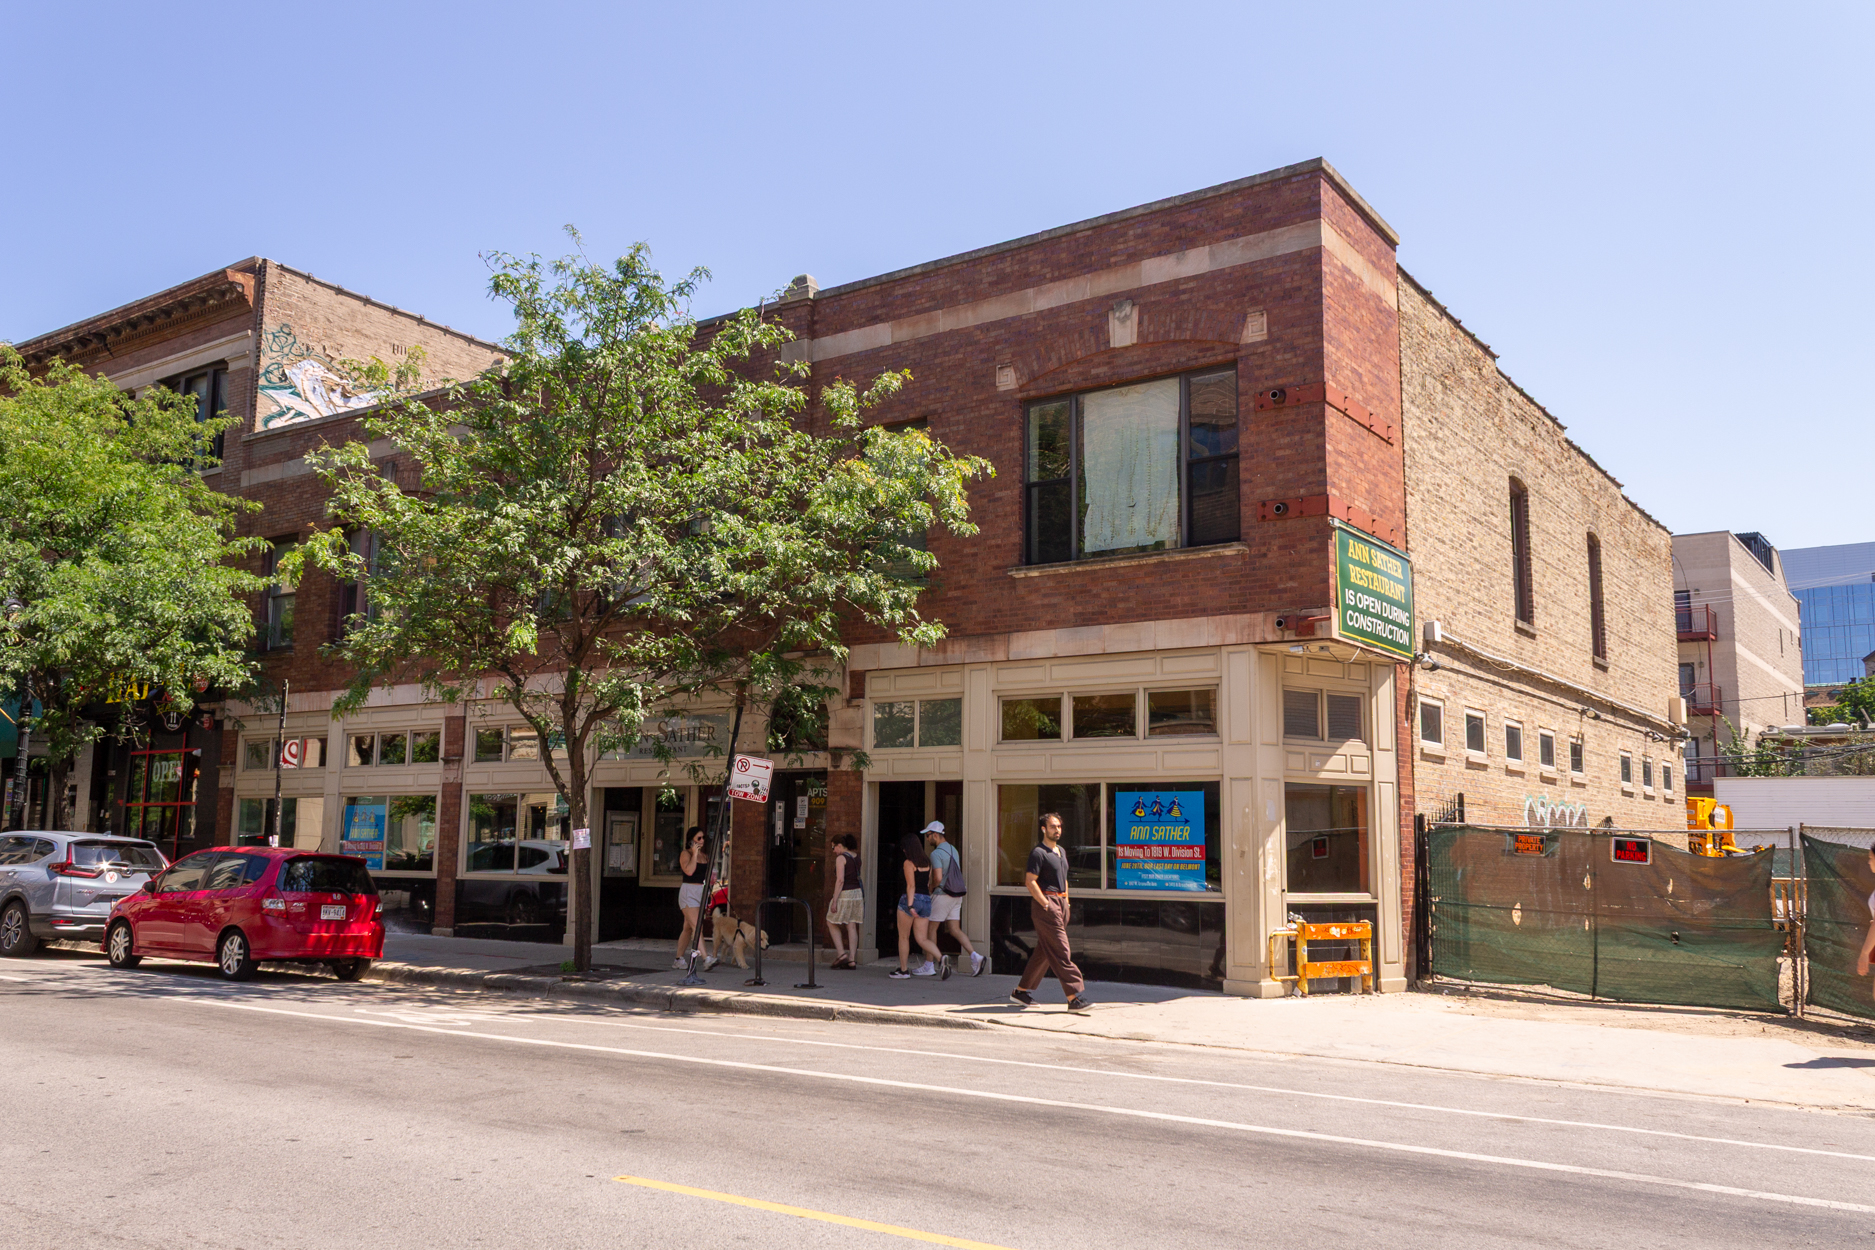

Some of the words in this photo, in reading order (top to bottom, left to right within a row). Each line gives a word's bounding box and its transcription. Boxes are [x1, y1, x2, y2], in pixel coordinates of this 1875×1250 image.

[1348, 539, 1370, 564] ANN
[1371, 550, 1403, 579] SATHER
[1348, 564, 1405, 603] RESTAURANT
[1345, 588, 1355, 606] IS
[1356, 593, 1382, 615] OPEN
[1382, 602, 1410, 627] DURING
[1346, 610, 1409, 646] CONSTRUCTION
[657, 720, 717, 744] SATHER
[639, 745, 687, 755] RESRANT
[731, 789, 745, 798] TOW
[807, 787, 827, 797] APTS
[811, 797, 825, 805] 909
[1130, 826, 1150, 840] ANN
[1152, 826, 1190, 840] SATHER
[1517, 835, 1541, 844] PRIVATE
[1118, 846, 1124, 857] Is
[1124, 846, 1143, 858] Moving
[1144, 846, 1150, 857] To
[1163, 846, 1171, 857] W.
[1172, 846, 1193, 858] Division
[1194, 847, 1202, 858] St.
[1515, 842, 1543, 851] PROPERTY
[1626, 841, 1637, 851] NO
[1616, 850, 1647, 862] PARKING
